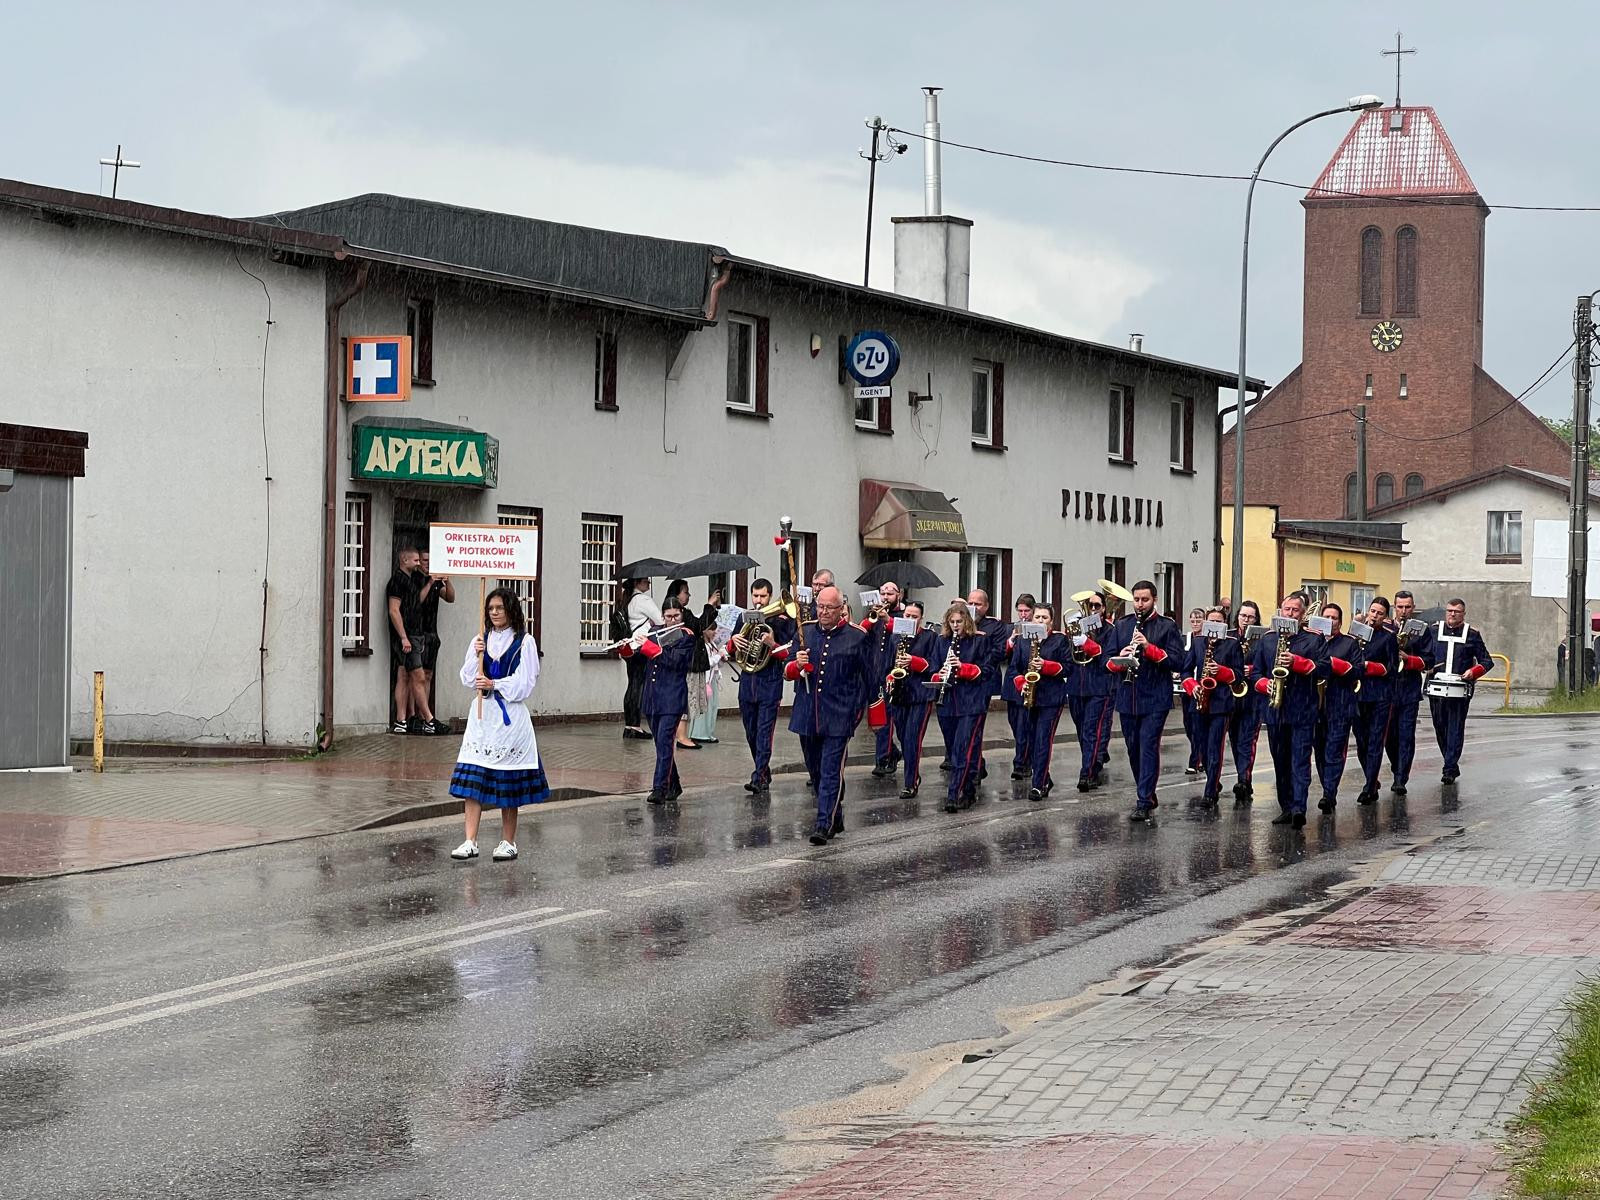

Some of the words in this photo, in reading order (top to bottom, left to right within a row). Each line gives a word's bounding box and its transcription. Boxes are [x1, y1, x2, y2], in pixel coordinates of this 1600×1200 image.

[857, 346, 885, 370] PZU
[364, 435, 483, 478] APTEKA
[1061, 488, 1164, 528] PIEKARNIA
[445, 533, 494, 543] ORKIESTRA
[500, 535, 521, 545] DĘTA
[447, 546, 455, 554] W
[459, 547, 515, 556] PIOTRKOWIE
[448, 559, 516, 569] TRYBUNALSKIM
